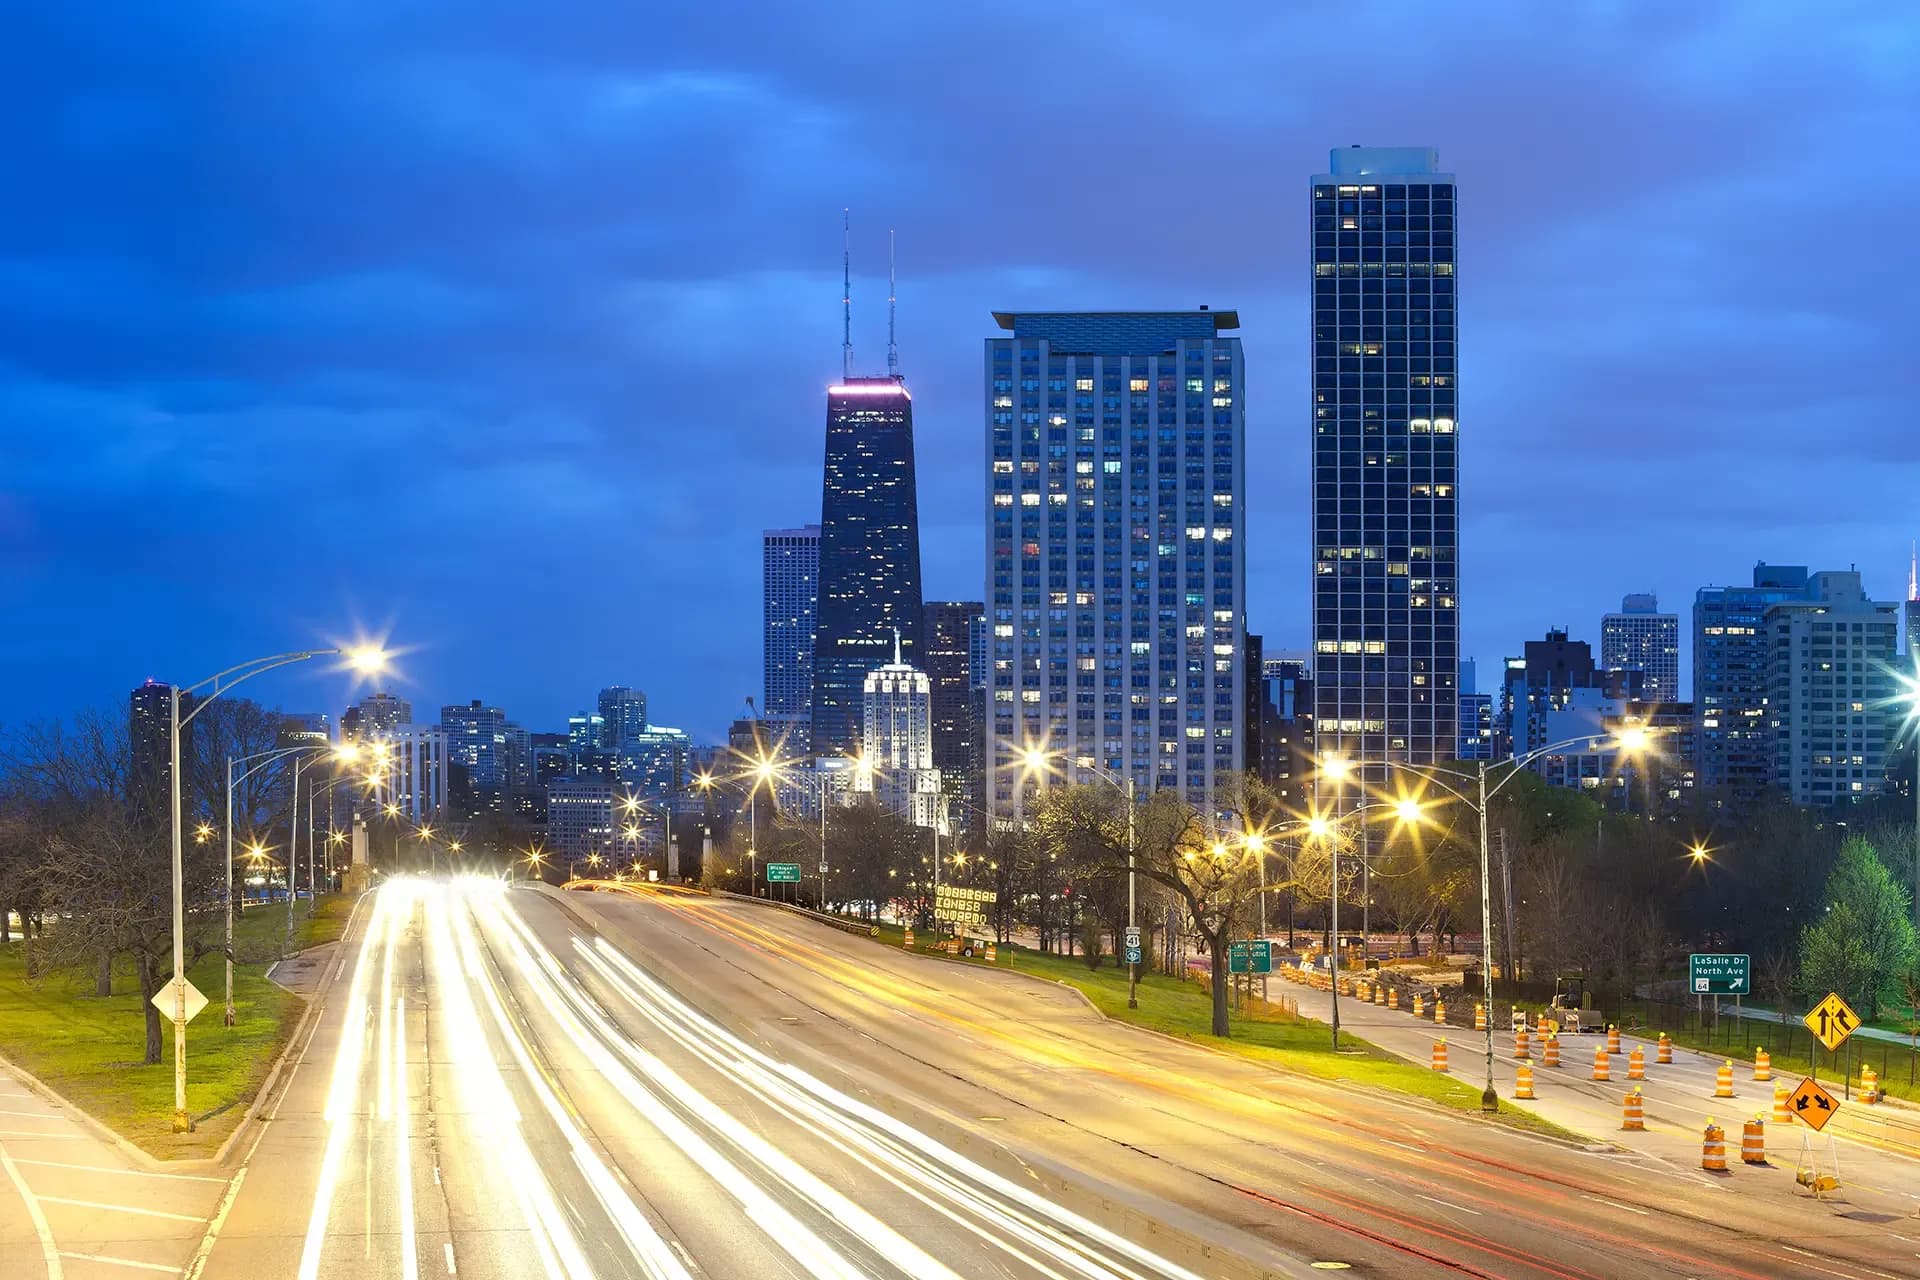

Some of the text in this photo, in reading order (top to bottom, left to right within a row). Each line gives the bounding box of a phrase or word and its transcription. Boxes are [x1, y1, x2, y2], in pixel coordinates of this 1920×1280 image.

[1128, 936, 1138, 945] 41
[1695, 957, 1745, 965] LaSalle Dr
[1696, 967, 1744, 975] North Ave
